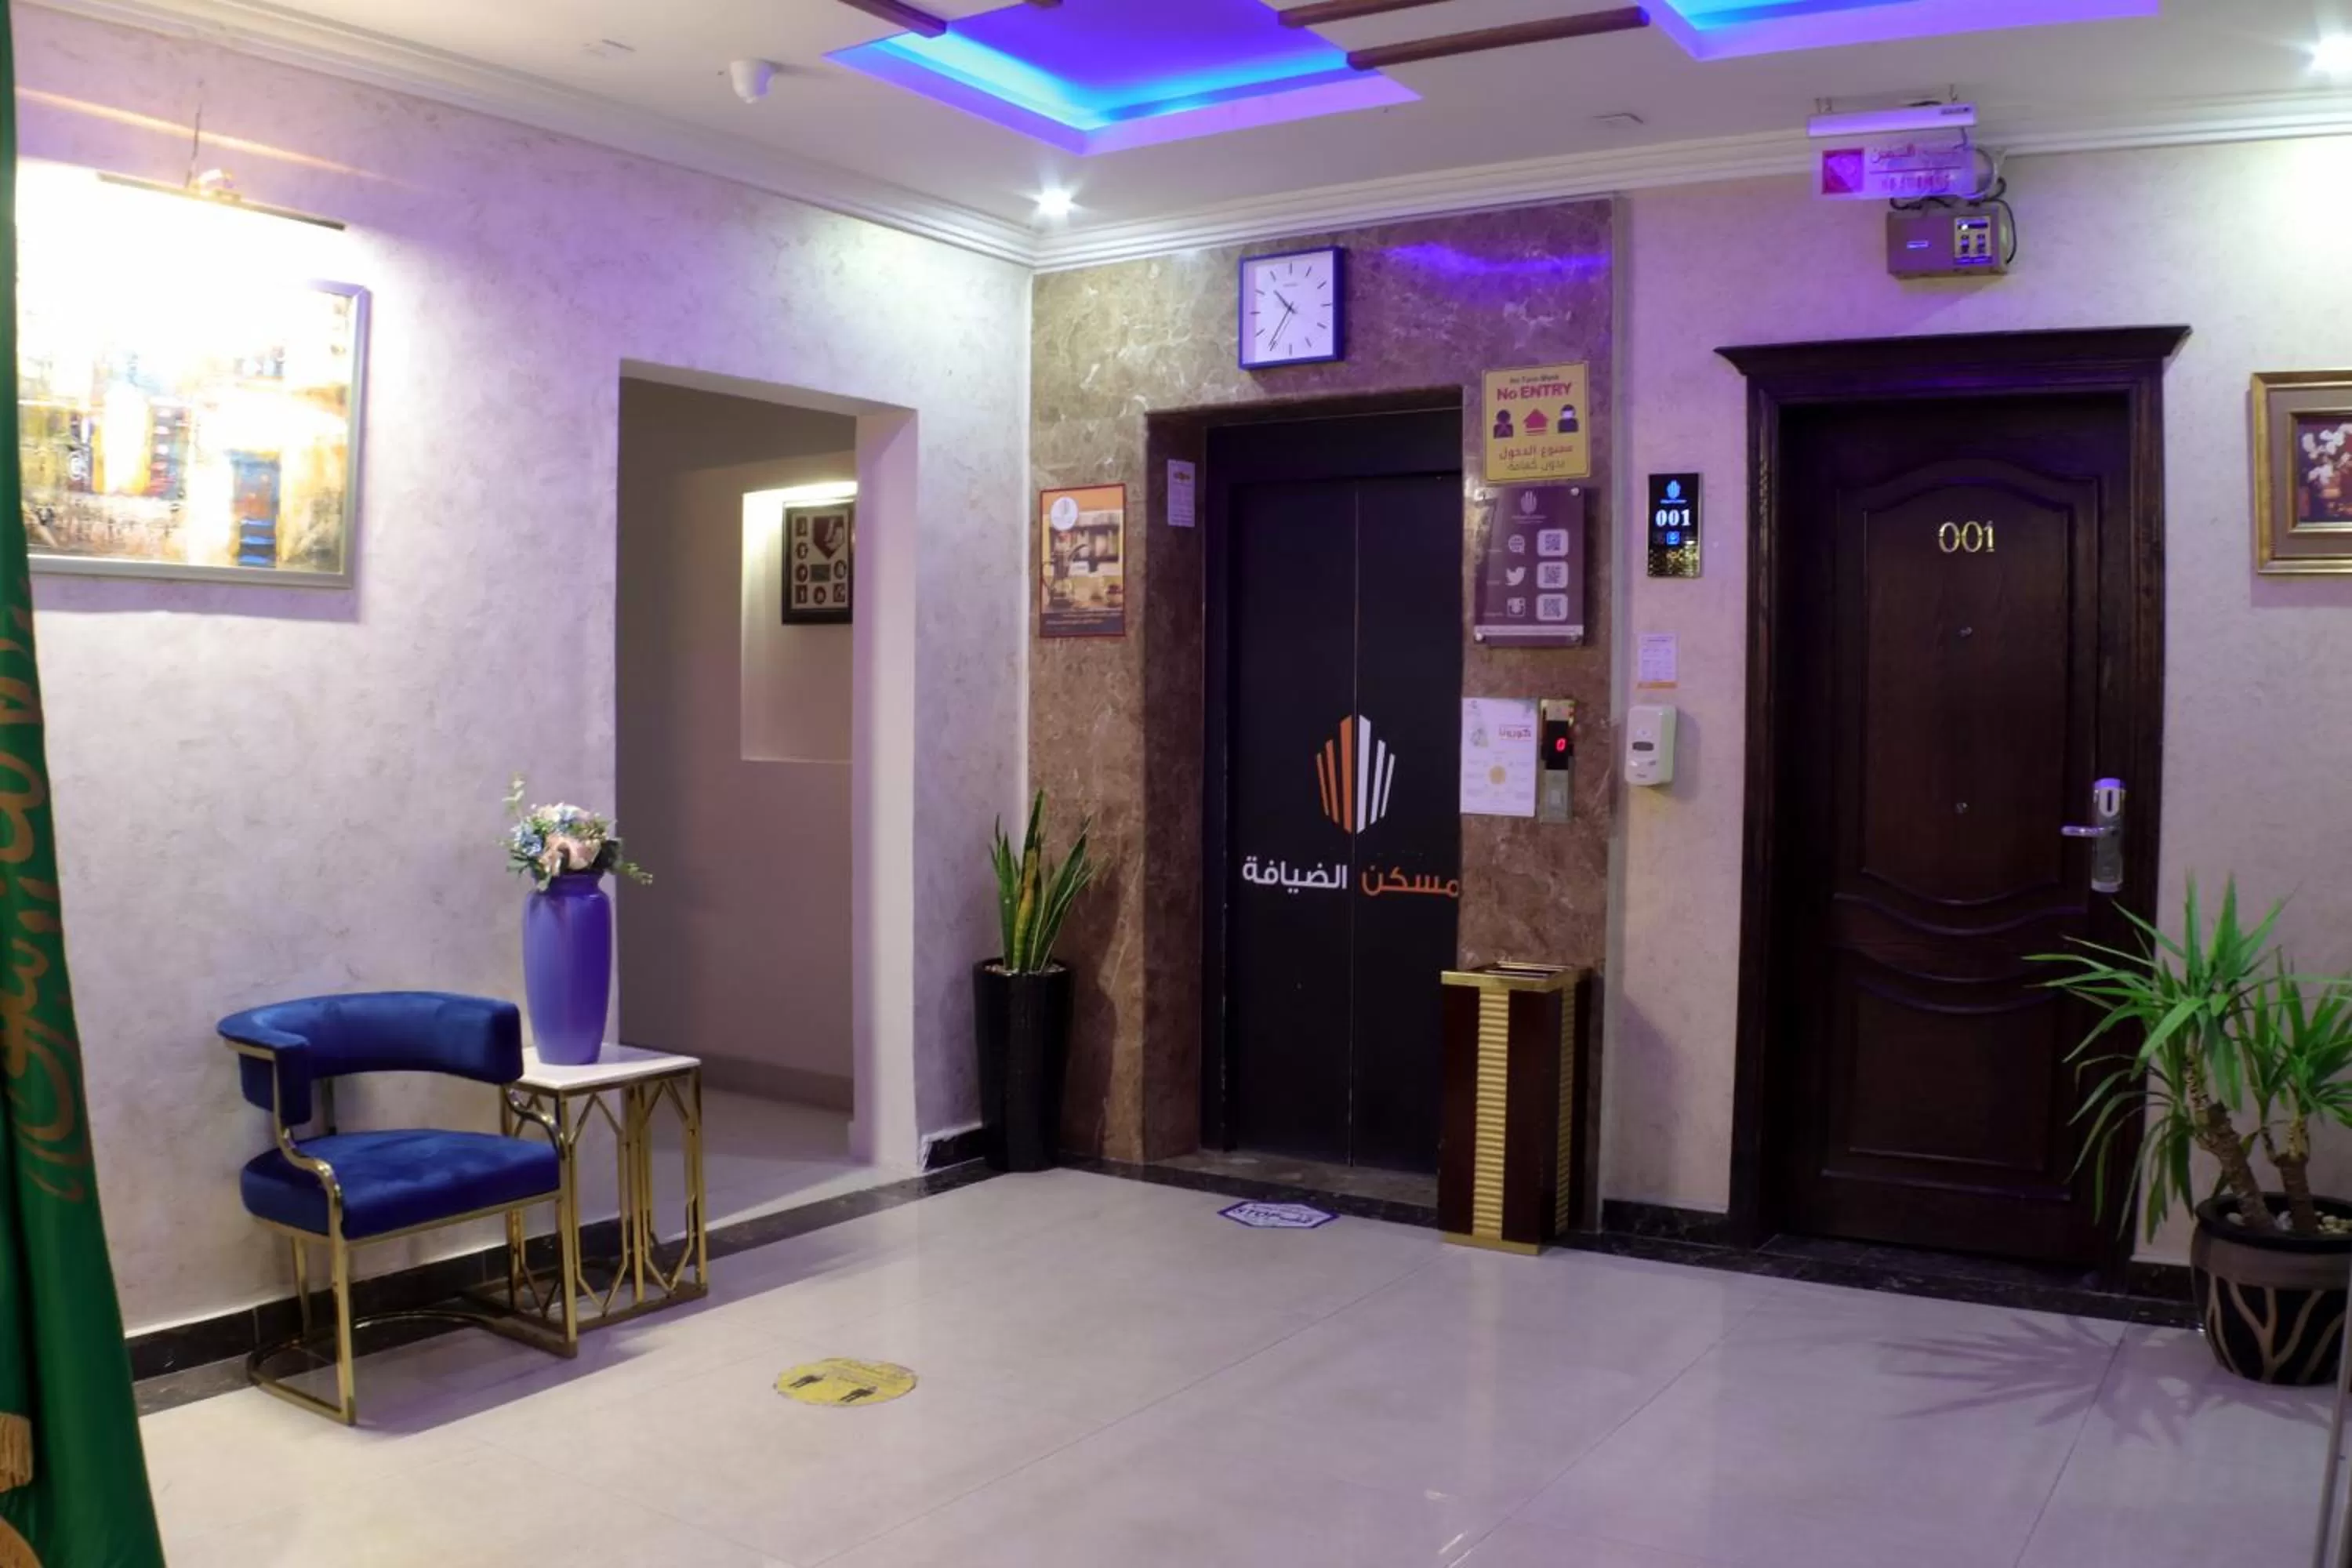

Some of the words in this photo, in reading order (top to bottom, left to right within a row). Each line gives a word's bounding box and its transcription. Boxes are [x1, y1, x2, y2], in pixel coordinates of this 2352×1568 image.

[1497, 387, 1518, 401] No
[1520, 382, 1572, 398] ENTRY
[1655, 509, 1691, 527] 001
[1938, 520, 1995, 553] 001
[1242, 855, 1348, 894] الضيافة
[1361, 865, 1460, 898] مسكن
